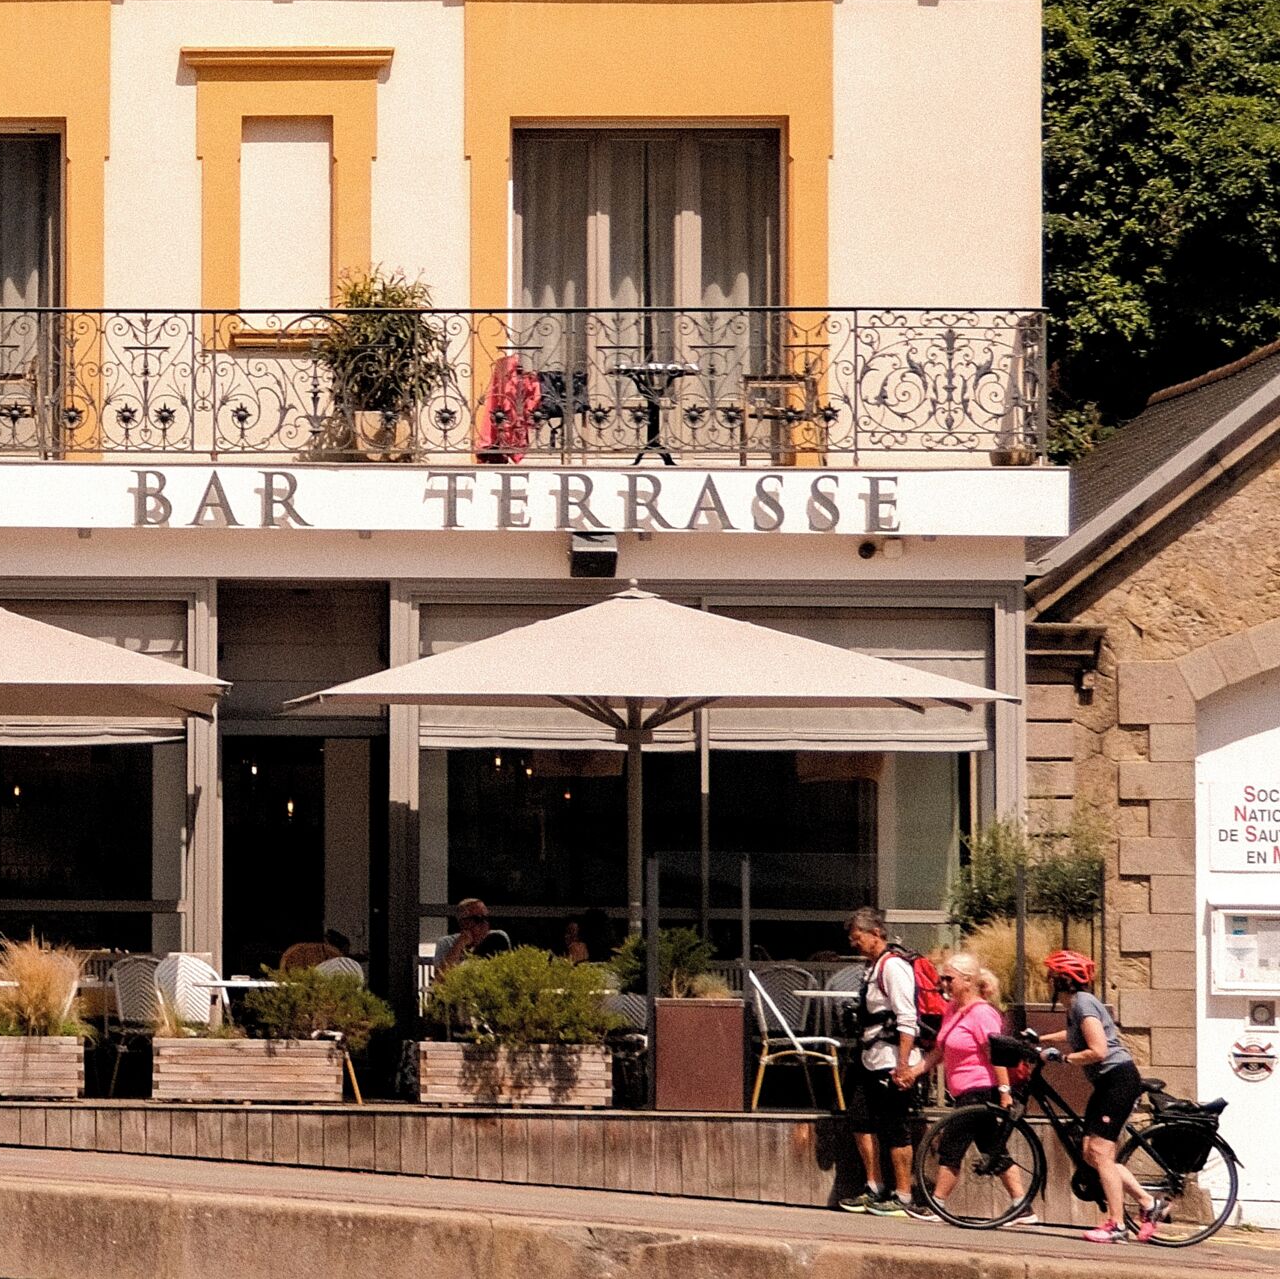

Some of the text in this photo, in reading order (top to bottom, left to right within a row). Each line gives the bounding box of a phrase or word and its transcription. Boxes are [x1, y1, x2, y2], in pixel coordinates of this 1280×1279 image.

[130, 469, 901, 533] BAR TERRASSE
[1218, 825, 1280, 843] DE SAU
[1246, 850, 1267, 864] EN
